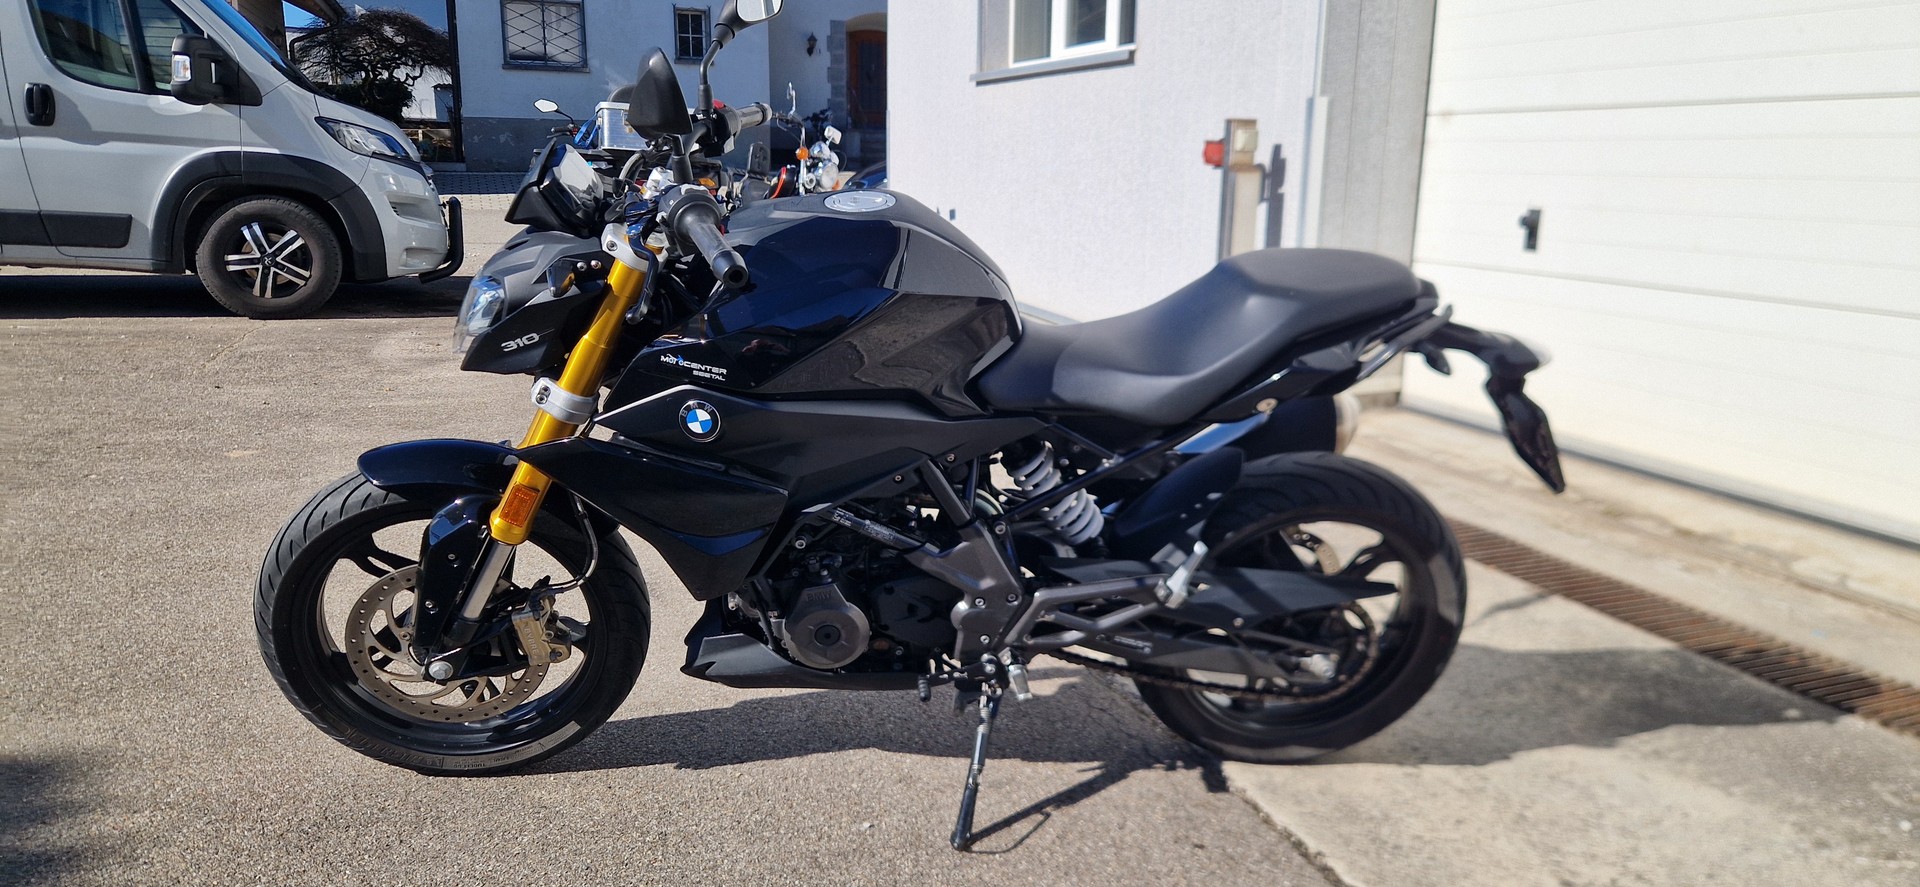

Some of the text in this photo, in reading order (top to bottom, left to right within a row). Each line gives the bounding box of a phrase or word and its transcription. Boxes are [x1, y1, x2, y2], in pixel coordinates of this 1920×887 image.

[501, 333, 539, 351] 310
[660, 354, 727, 375] MOTOCENTER
[680, 401, 714, 418] BMW
[806, 590, 833, 601] BMW
